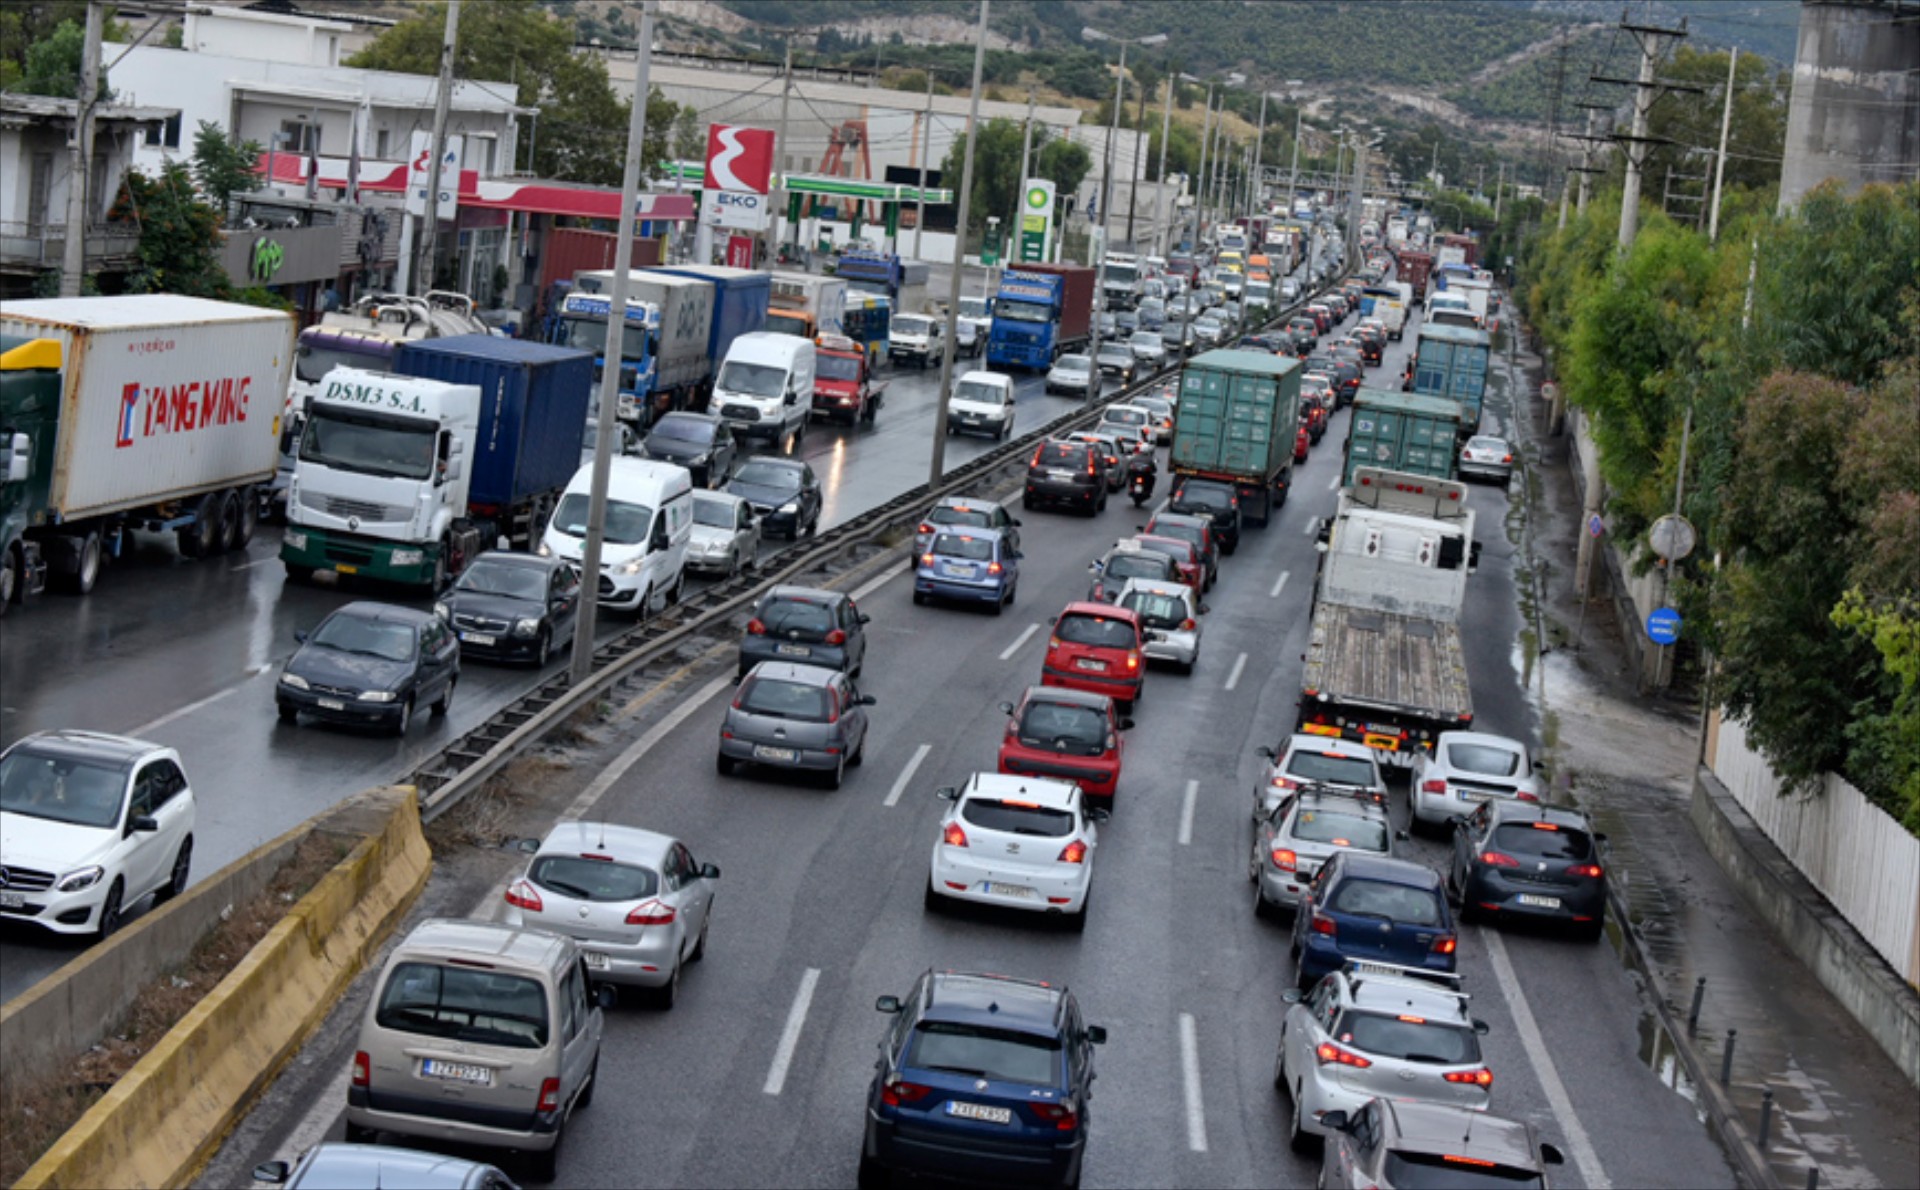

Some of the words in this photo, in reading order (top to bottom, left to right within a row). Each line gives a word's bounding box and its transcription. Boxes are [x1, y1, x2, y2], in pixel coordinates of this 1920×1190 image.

[718, 194, 758, 208] EKO
[143, 382, 200, 437] YANG
[325, 382, 383, 404] DSM3
[387, 391, 427, 413] S.A.
